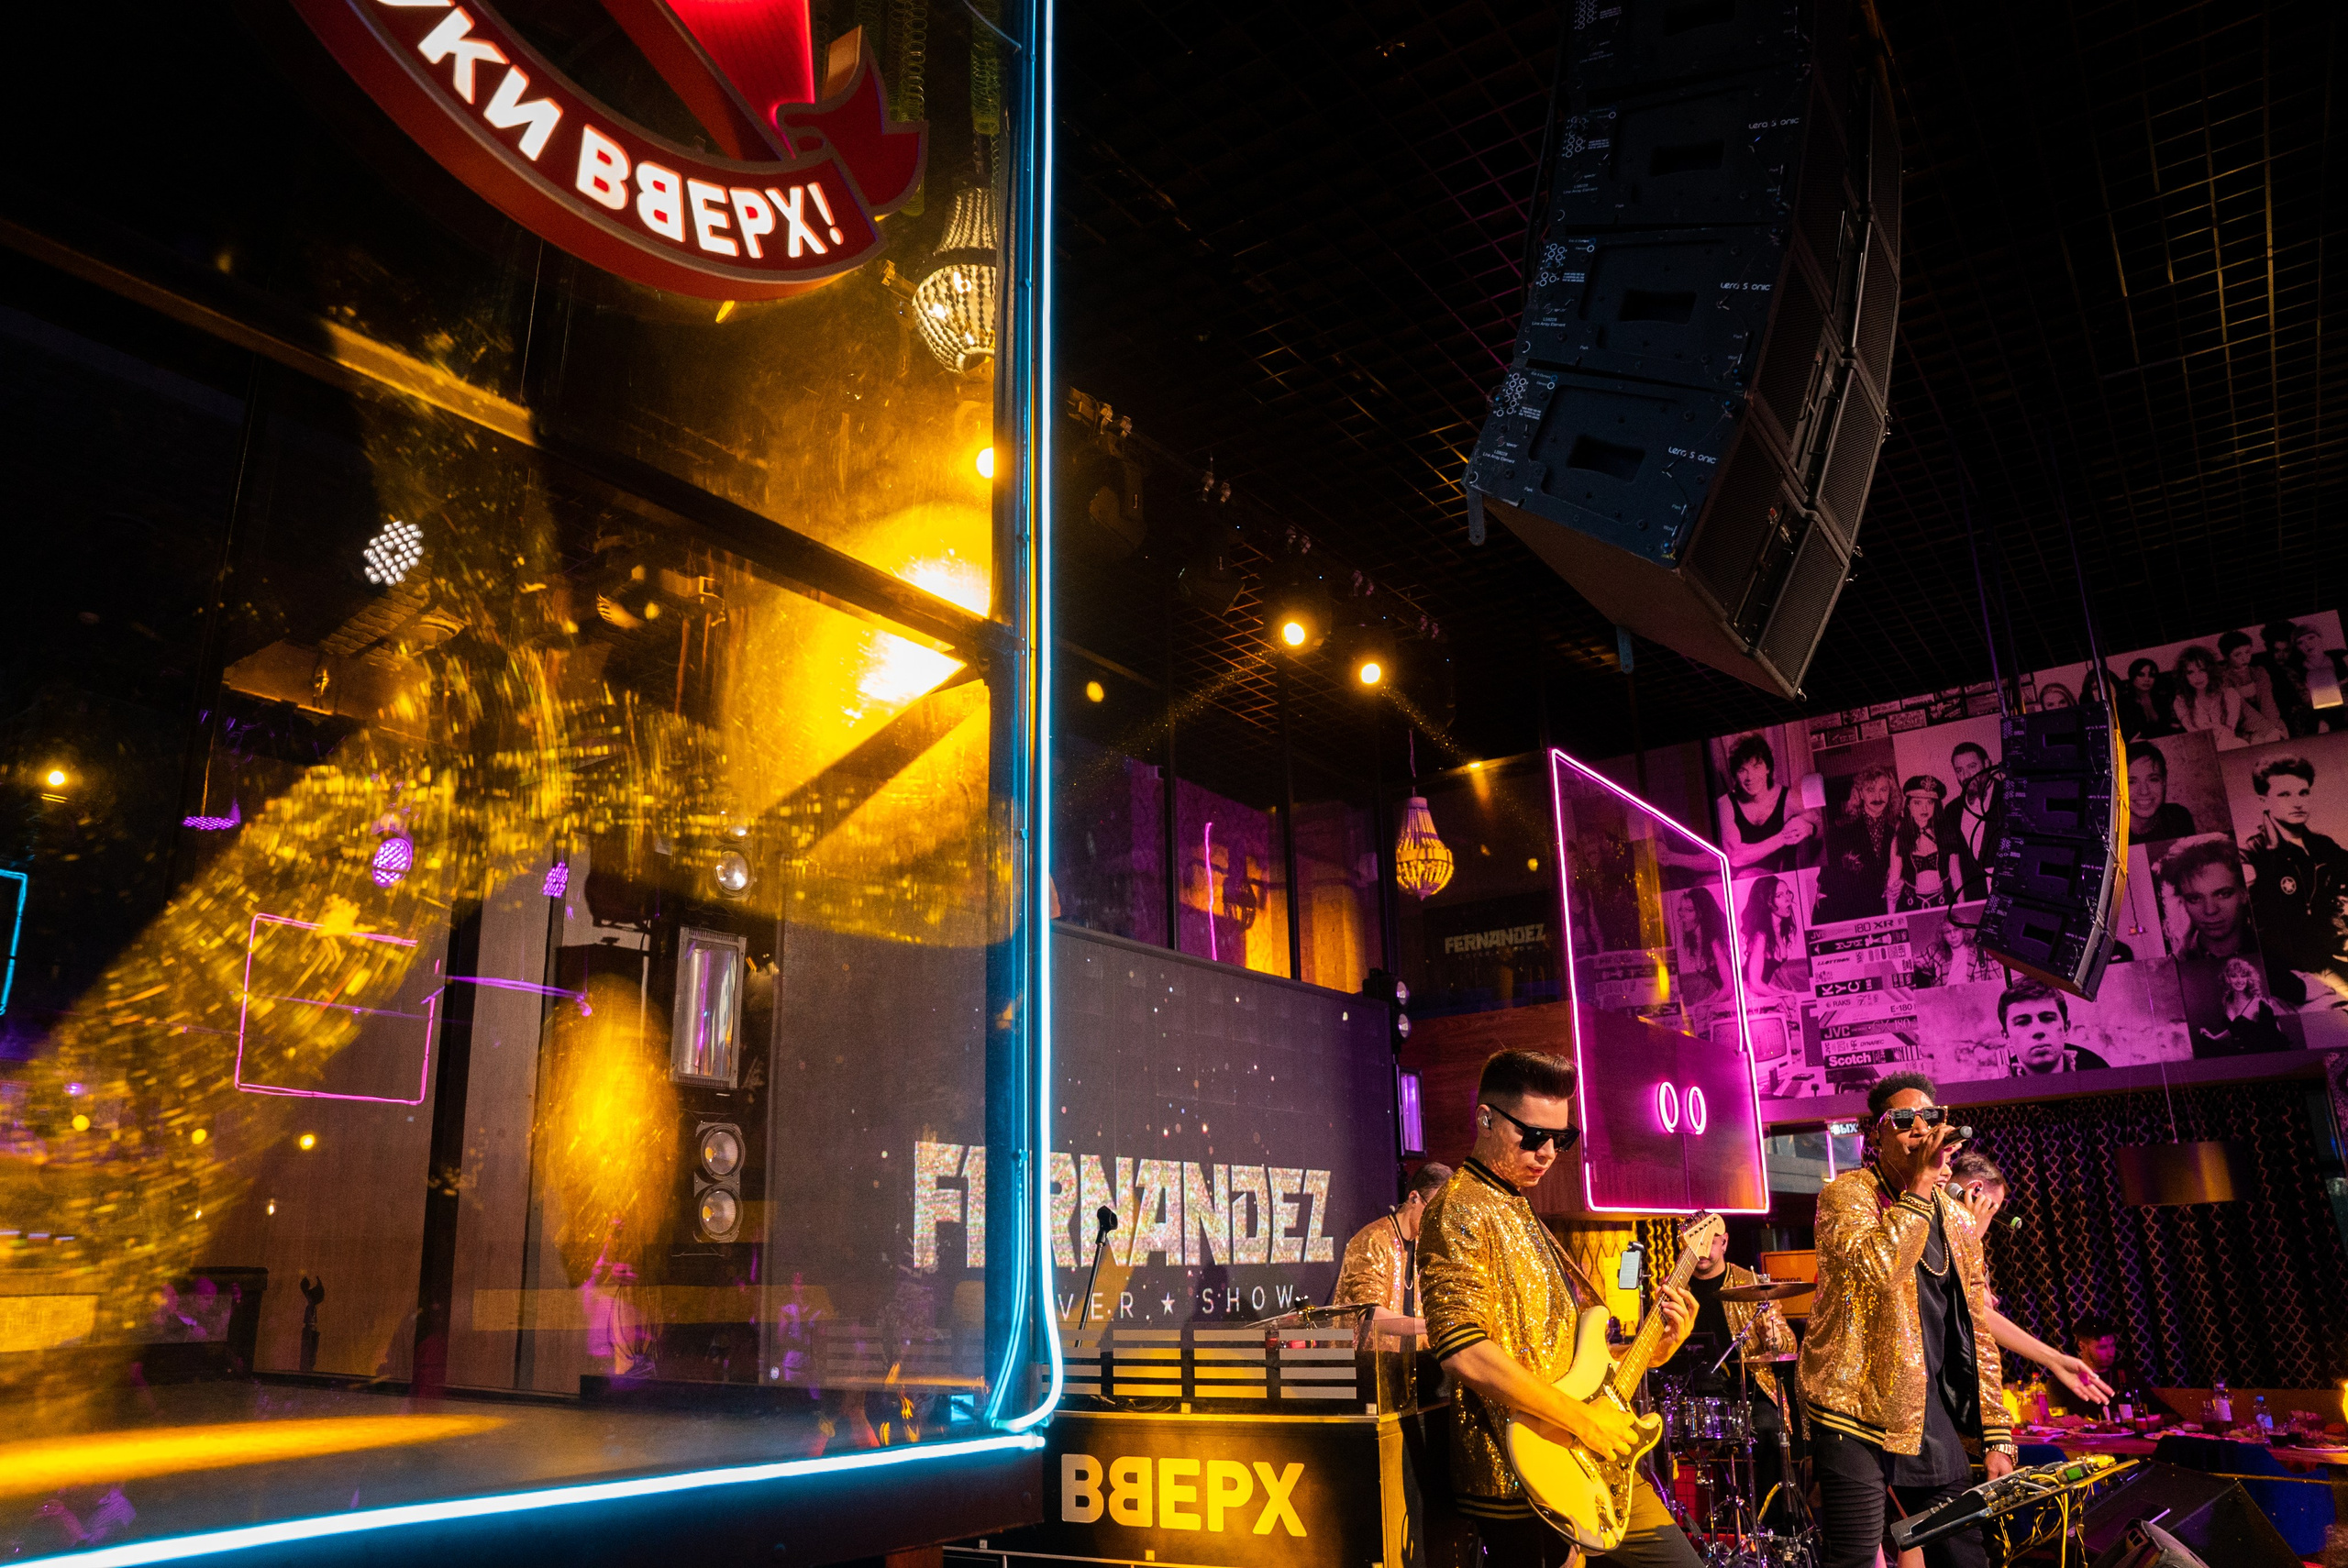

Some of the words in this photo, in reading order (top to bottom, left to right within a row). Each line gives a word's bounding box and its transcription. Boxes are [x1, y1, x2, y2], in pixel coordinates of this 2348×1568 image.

[377, 0, 564, 161] КИ
[1854, 922, 1872, 933] 180
[1873, 919, 1894, 929] XR
[1445, 922, 1546, 955] FERNANDEZ
[1833, 999, 1851, 1008] RAKS
[1890, 1004, 1912, 1013] E-180
[1824, 1026, 1851, 1039] JVC
[1828, 1052, 1872, 1067] Scotch
[1202, 1284, 1294, 1315] SHOW
